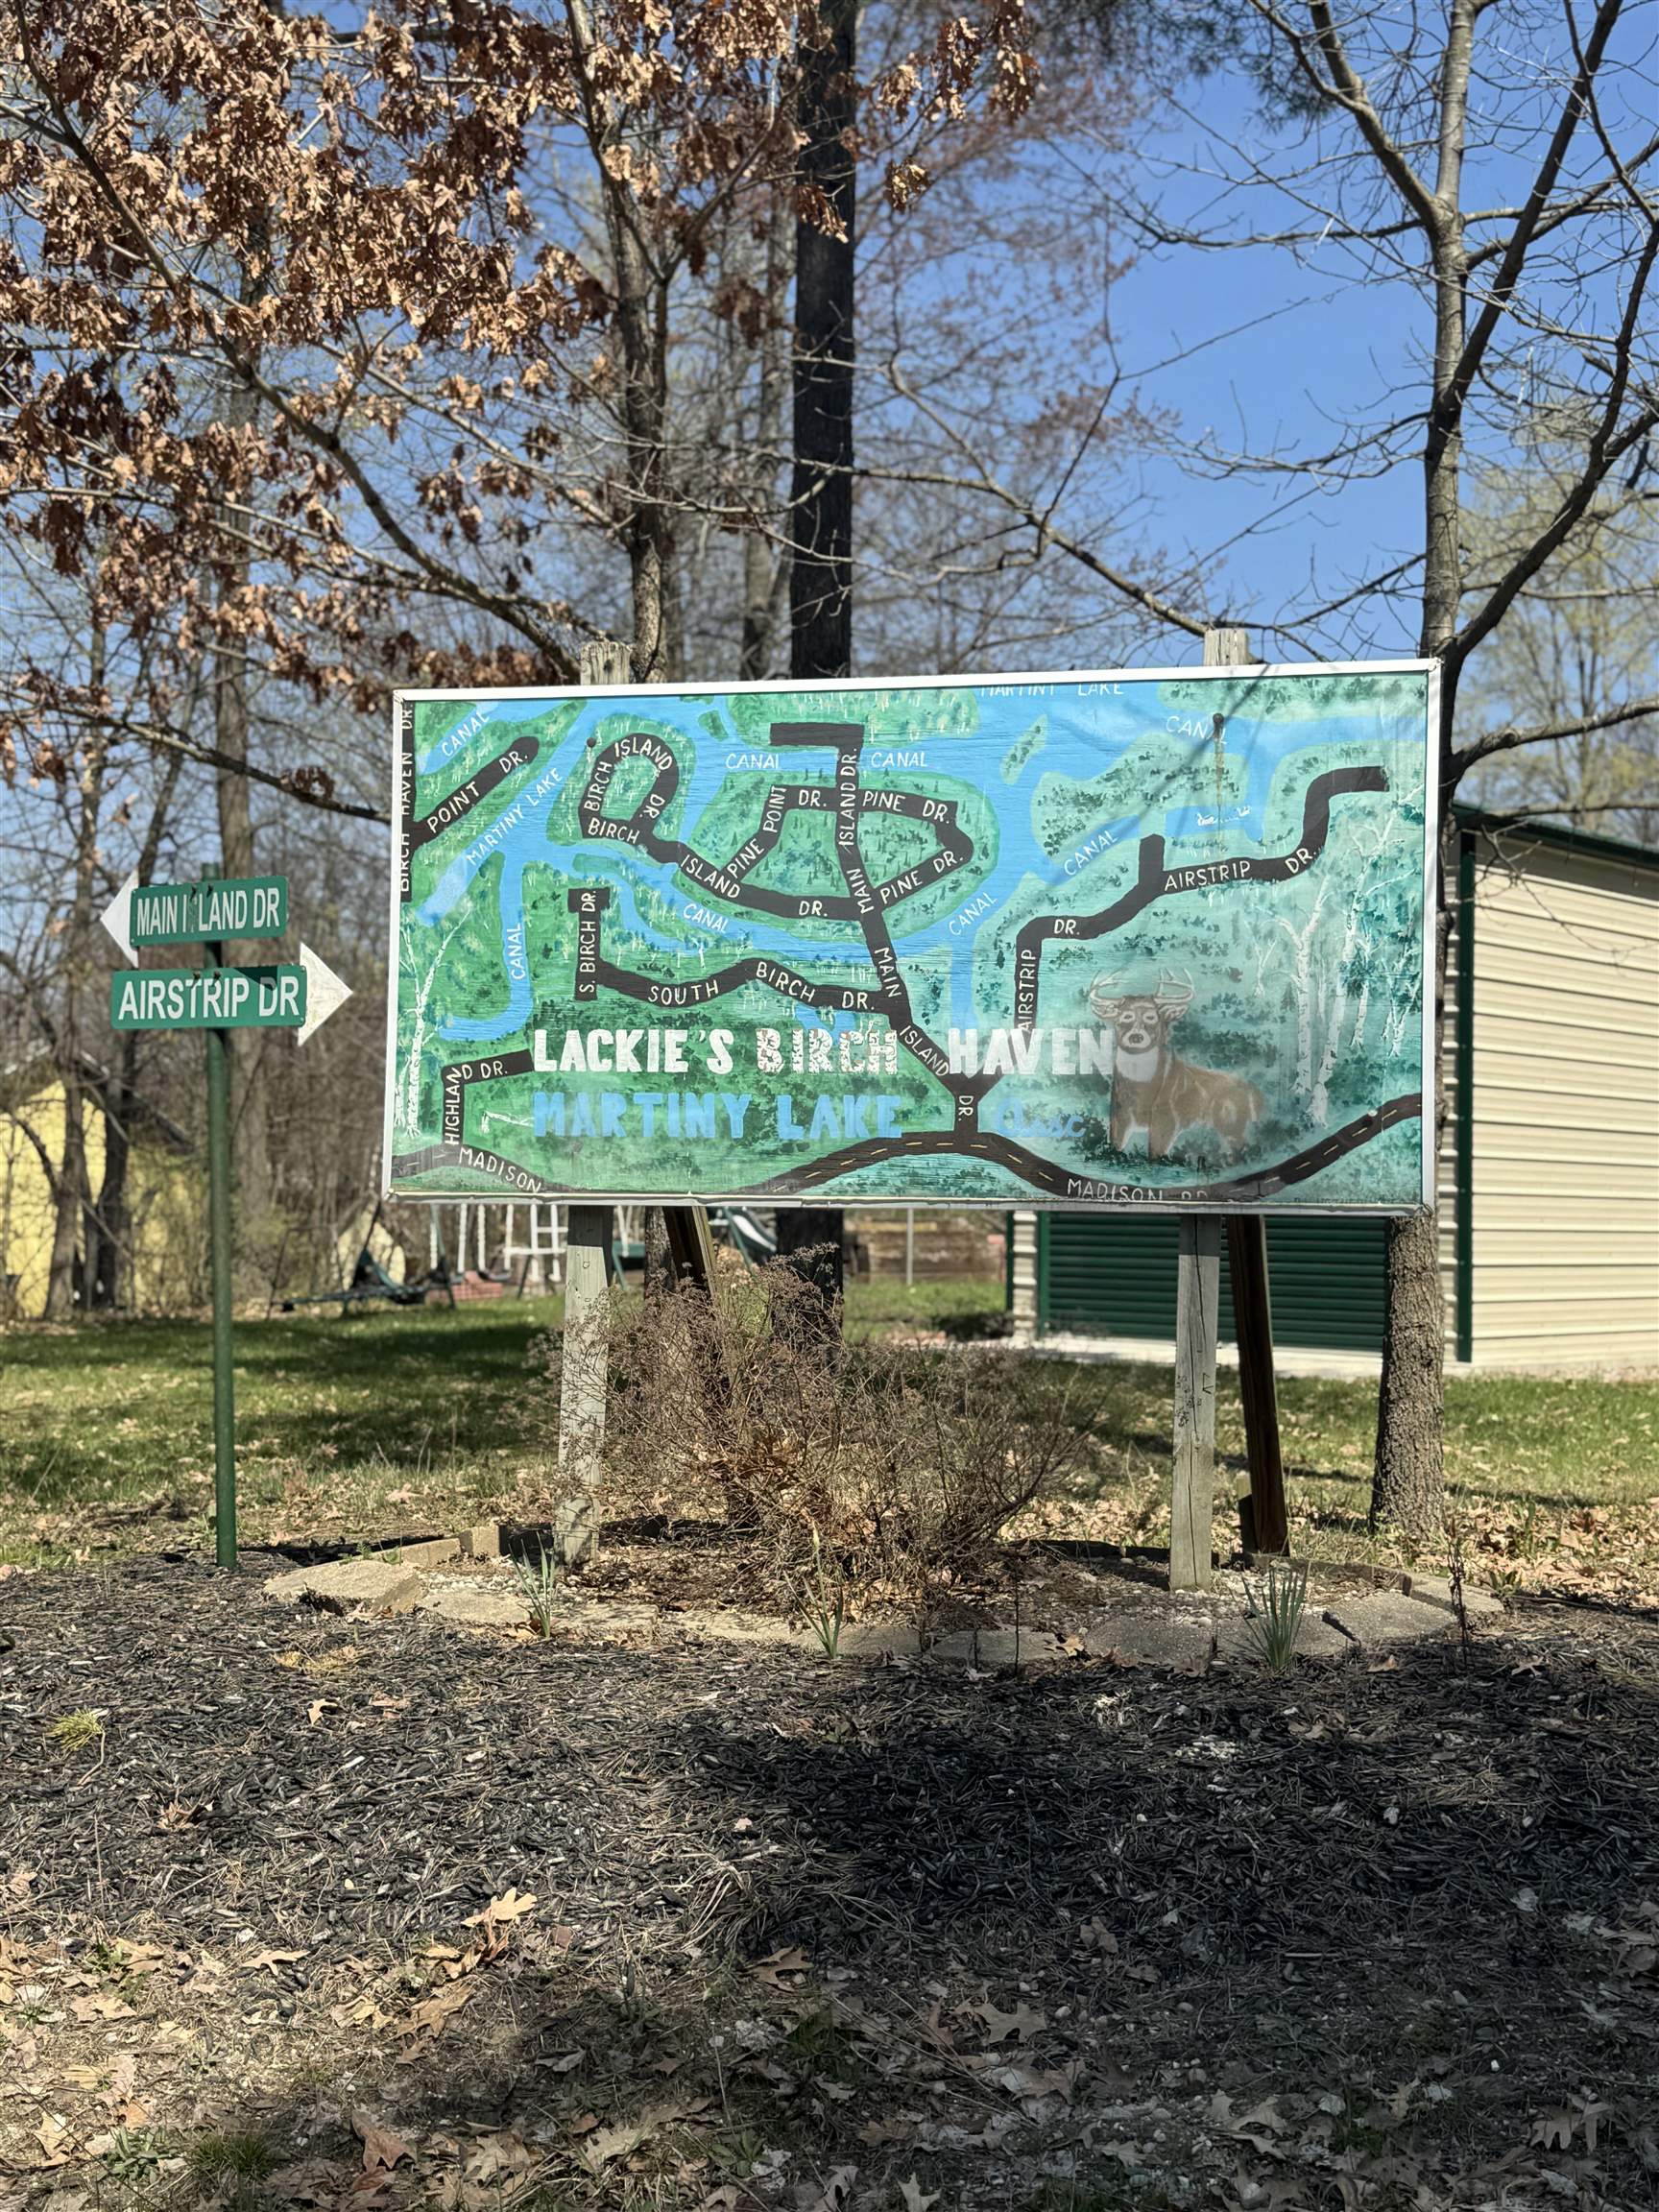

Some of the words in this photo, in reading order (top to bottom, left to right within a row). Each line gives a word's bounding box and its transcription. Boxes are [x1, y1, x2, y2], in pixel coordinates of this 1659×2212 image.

[1077, 683, 1124, 697] LAKE
[441, 710, 490, 757] CANAL
[614, 736, 673, 771] ISLAND
[1166, 714, 1228, 745] CANL
[840, 747, 857, 777] DR.
[871, 751, 928, 769] CANAL
[426, 781, 481, 834] POINT
[498, 751, 529, 774] DR.
[584, 761, 613, 812] BIRCH
[639, 793, 666, 820] DR.
[863, 790, 906, 813] PINE
[923, 800, 950, 825] DR.
[466, 804, 525, 866] MARTINY
[527, 768, 564, 806] LAKE
[727, 838, 765, 878] PINE
[762, 784, 787, 833] POINT
[798, 789, 828, 808] DR.
[838, 781, 856, 848] ISLAND
[588, 817, 641, 845] BIRCH
[680, 854, 742, 900] ISLAND
[798, 901, 829, 917] DR.
[1063, 829, 1119, 877] CANAL
[1164, 860, 1252, 892] AIRSTRIP
[581, 889, 597, 913] DR.
[847, 868, 875, 914] MAIN
[879, 870, 924, 905] PINE
[932, 851, 964, 875] DR.
[136, 894, 179, 937] MAIN
[182, 889, 248, 934] ILAND
[252, 887, 280, 929] DR
[682, 902, 730, 935] CANAL
[949, 892, 998, 937] CANAL
[506, 923, 526, 980] CANAL
[580, 921, 597, 973] BIRCH
[117, 976, 251, 1022] AIRSTRIP
[258, 975, 300, 1018] DR
[579, 979, 595, 994] S.
[647, 978, 720, 1006] SOUTH
[755, 961, 816, 1003] BIRCH
[842, 991, 876, 1011] DR.
[1018, 949, 1038, 1033] AIRSTRIP
[1053, 919, 1081, 936] DR.
[533, 1028, 734, 1075] LACKIE'S
[755, 1027, 899, 1076] BIRCH
[947, 1027, 1117, 1079] HAVEN
[874, 946, 902, 999] MAIN
[899, 1023, 950, 1077] ISLAND
[957, 1094, 974, 1122] DR.
[444, 1064, 473, 1146] HIGHLAND
[479, 1060, 508, 1078] DR.
[532, 1091, 753, 1140] MARTINY
[776, 1094, 902, 1140] LAKE
[458, 1146, 542, 1194] MADISON
[1067, 1177, 1164, 1201] MADISON
